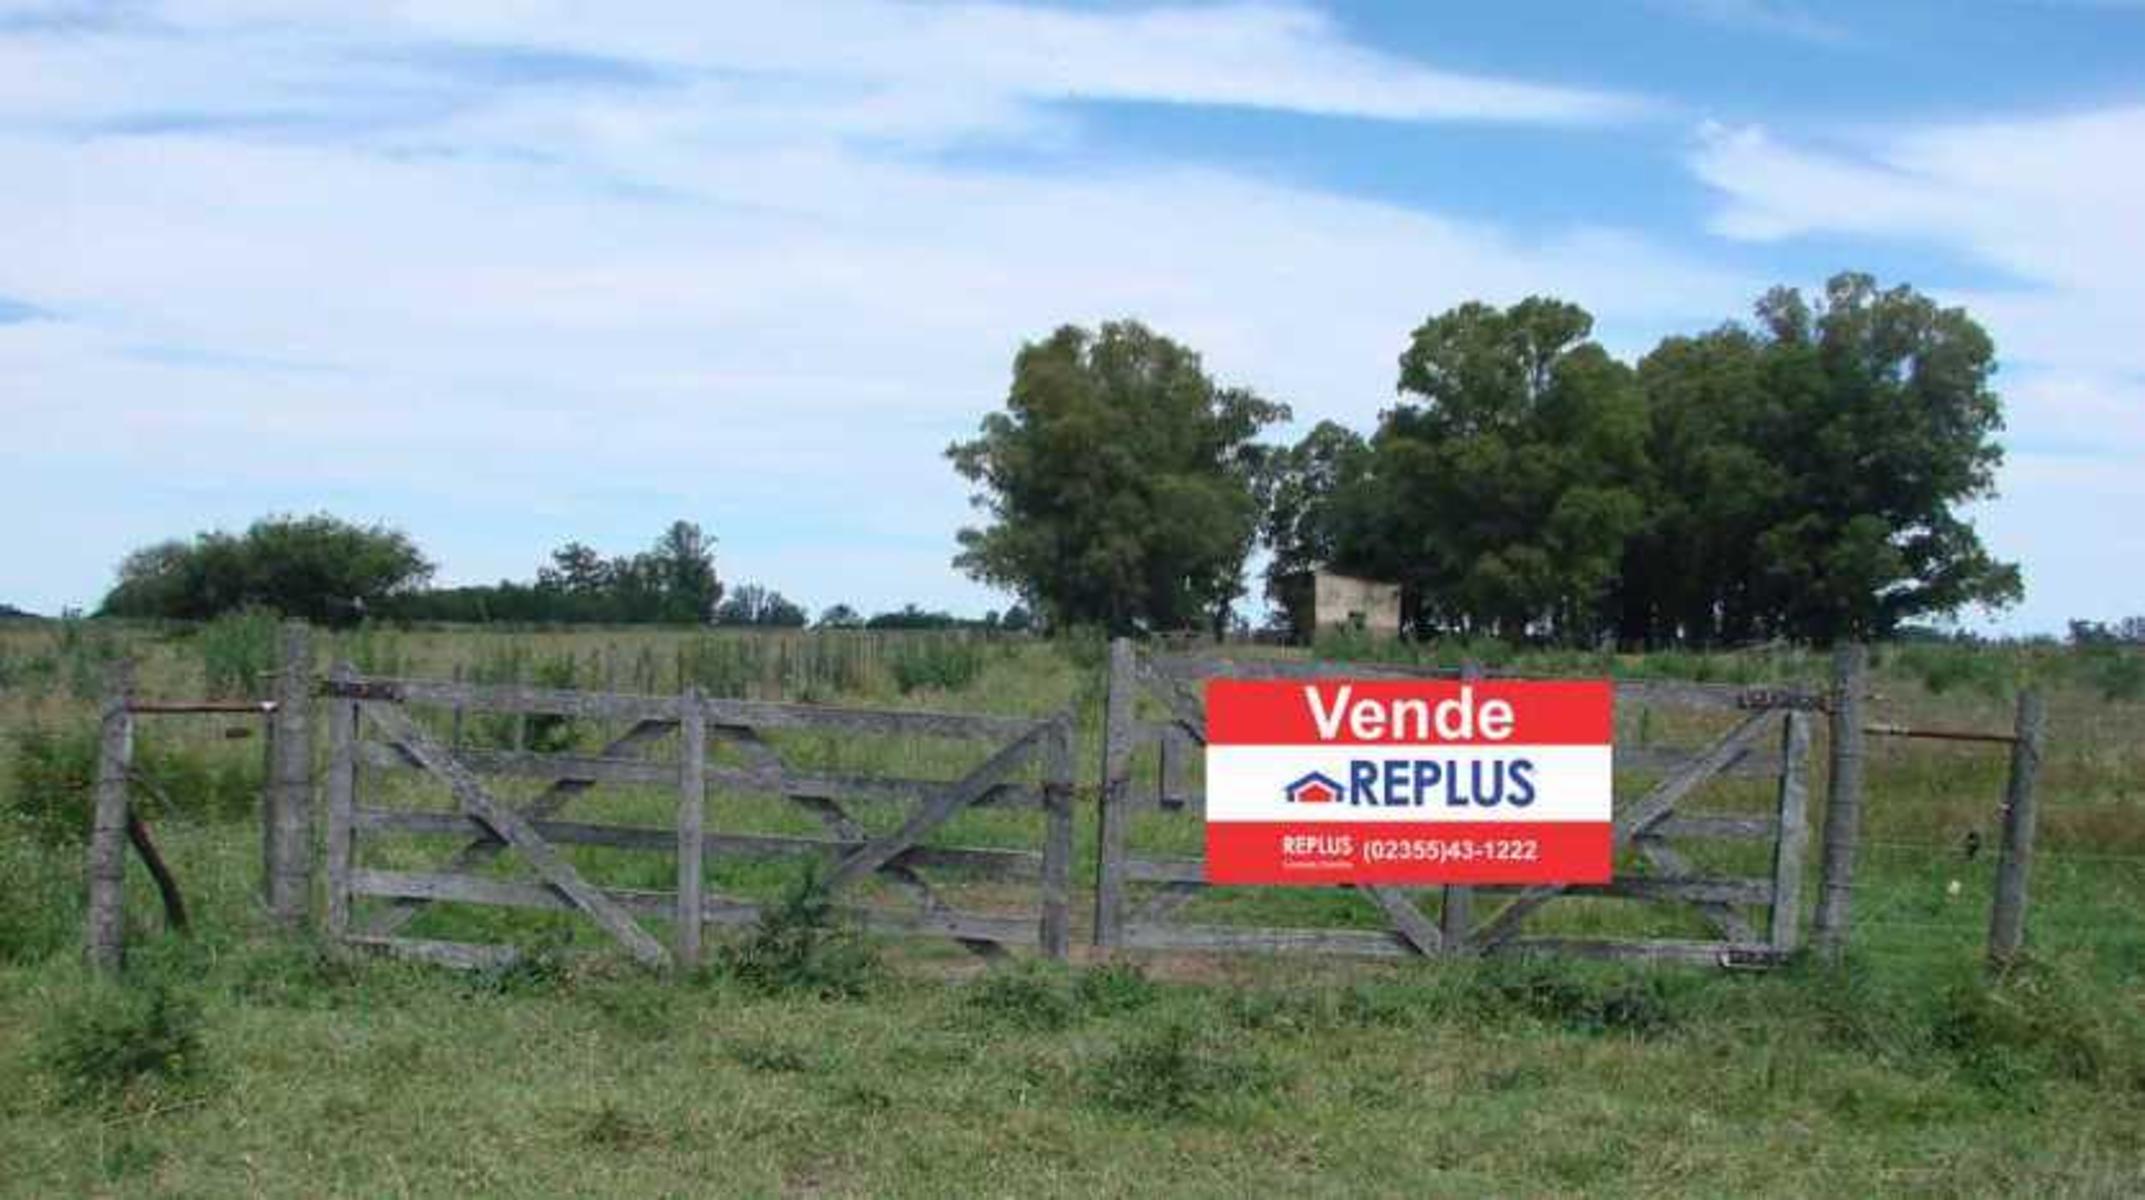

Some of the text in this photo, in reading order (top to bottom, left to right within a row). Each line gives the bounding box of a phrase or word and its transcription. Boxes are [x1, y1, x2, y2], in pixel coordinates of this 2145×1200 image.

[1304, 685, 1515, 741] Vende
[1350, 759, 1536, 807] REPLUS
[1282, 835, 1355, 857] REPLUS
[1362, 838, 1539, 865] (02355)43-1222
